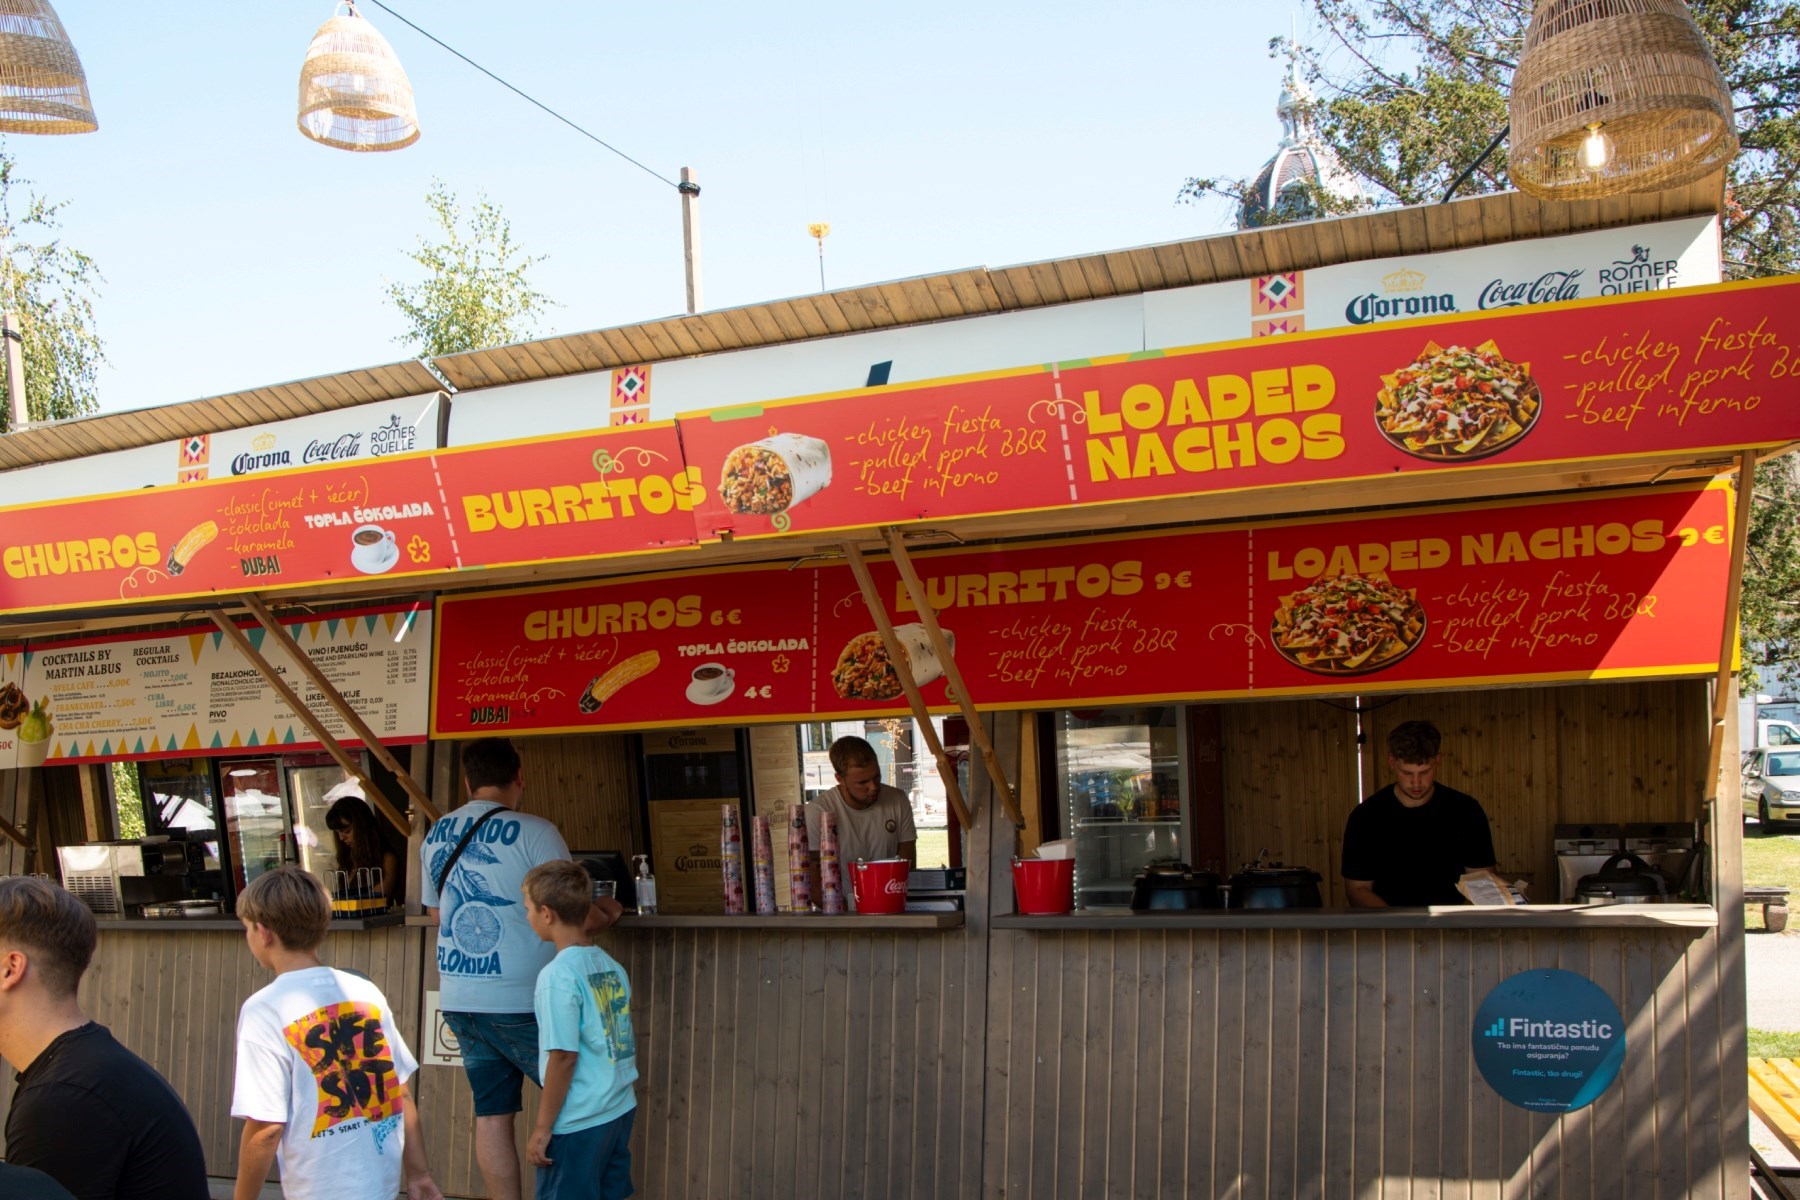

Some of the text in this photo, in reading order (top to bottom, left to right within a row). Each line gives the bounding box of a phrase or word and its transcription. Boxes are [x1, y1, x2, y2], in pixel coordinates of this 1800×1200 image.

[1477, 268, 1586, 311] Coca-Cola
[1345, 291, 1456, 325] Corona
[1695, 316, 1778, 365] fiesta
[1680, 350, 1755, 398] pork
[1083, 364, 1336, 435] LOADED
[1658, 384, 1761, 427] inferno
[943, 405, 1001, 445] fiesta
[303, 432, 364, 464] Coca-Cola
[371, 438, 415, 457] QUELLE
[937, 435, 989, 472] pork
[1000, 427, 1047, 458] BBQ
[1085, 412, 1346, 483] NACHOS
[231, 450, 293, 475] Corona
[924, 461, 999, 497] inferno
[462, 465, 707, 533] BURRITOS
[304, 502, 434, 529] TOPLA ČOKOLADA
[3, 531, 161, 579] CHURROS
[1267, 519, 1666, 580] LOADED NACHOS
[240, 555, 282, 576] DUBAI
[1545, 570, 1610, 608] fiesta
[523, 595, 702, 641] CHURROS
[1080, 607, 1139, 641] fiesta
[1531, 602, 1588, 634] pork
[1604, 594, 1658, 621] BBQ
[42, 649, 112, 666] COCKTAILS BY
[133, 645, 171, 656] REGULAR
[308, 647, 327, 656] VINO
[337, 652, 368, 661] SPARKLING
[678, 638, 809, 657] TOPLA ČOKOLADA
[1072, 635, 1122, 666] pork
[1131, 627, 1178, 653] BBQ
[1511, 630, 1598, 658] inferno
[45, 663, 122, 680] MARTIN ALBUS
[136, 654, 180, 666] COCKTAILS
[1054, 658, 1128, 687] inferno
[143, 670, 170, 678] MOJITO
[211, 669, 260, 680] BEZALKOHOL
[147, 693, 165, 701] CUBA
[340, 690, 360, 698] AKIJE
[210, 710, 227, 718] PIVO
[470, 706, 511, 725] DUBAI
[668, 735, 708, 750] Corona
[674, 856, 721, 873] Corona
[437, 946, 502, 975] FLORIDA
[1510, 1018, 1612, 1039] Fintastic
[1497, 1041, 1511, 1049] Tko
[1512, 1042, 1526, 1050] ima
[1571, 1044, 1600, 1052] ponudu
[1526, 1052, 1570, 1060] osiguranja?
[339, 1122, 360, 1134] START
